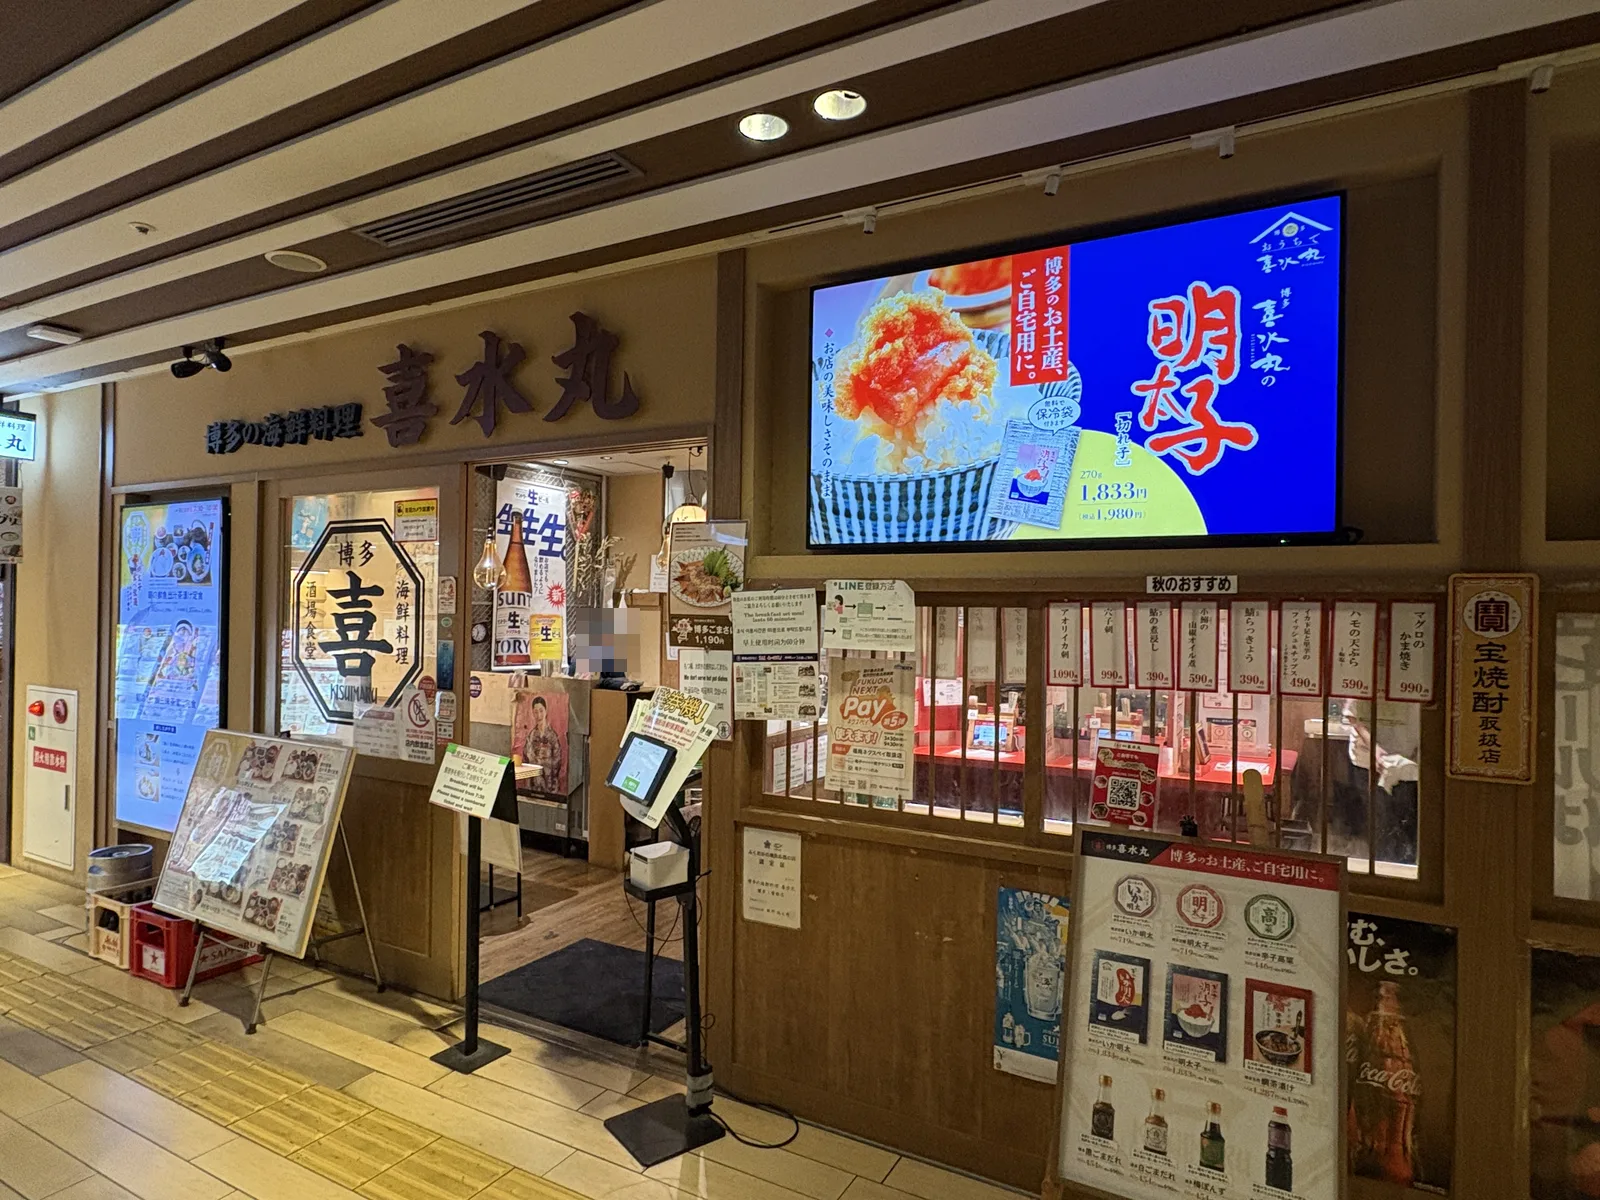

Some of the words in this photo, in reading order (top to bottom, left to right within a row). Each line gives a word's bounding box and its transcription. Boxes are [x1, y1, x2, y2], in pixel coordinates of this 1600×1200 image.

[1041, 256, 1064, 376] 博多のお土産、
[1280, 287, 1292, 309] 博多
[1016, 268, 1037, 380] ご自宅用に。
[370, 311, 639, 448] 喜水丸
[1131, 280, 1258, 476] 明太子
[206, 403, 363, 454] 博多の海鮮料理
[822, 342, 835, 498] お店の美味しさそのまま
[1036, 406, 1073, 420] 保冷袋
[528, 489, 538, 505] 生
[1082, 482, 1147, 503] 1,833円
[337, 540, 374, 567] 博多
[1151, 576, 1231, 592] 秋のおすすめ
[305, 581, 317, 661] 酒場食堂
[318, 571, 394, 677] 喜
[395, 580, 411, 666] 海鮮料理
[508, 611, 520, 629] 生
[541, 626, 552, 641] 生
[1413, 611, 1426, 649] マグロの
[1399, 631, 1411, 671] かま焼き
[852, 685, 878, 695] NEXT
[857, 677, 894, 685] FUKUOKA
[844, 697, 887, 724] Pay
[1472, 641, 1510, 765] 宝焼酎取扱店
[1117, 843, 1150, 857] 喜水丸
[1169, 848, 1326, 884] 博多のお土産、ご自宅用に。
